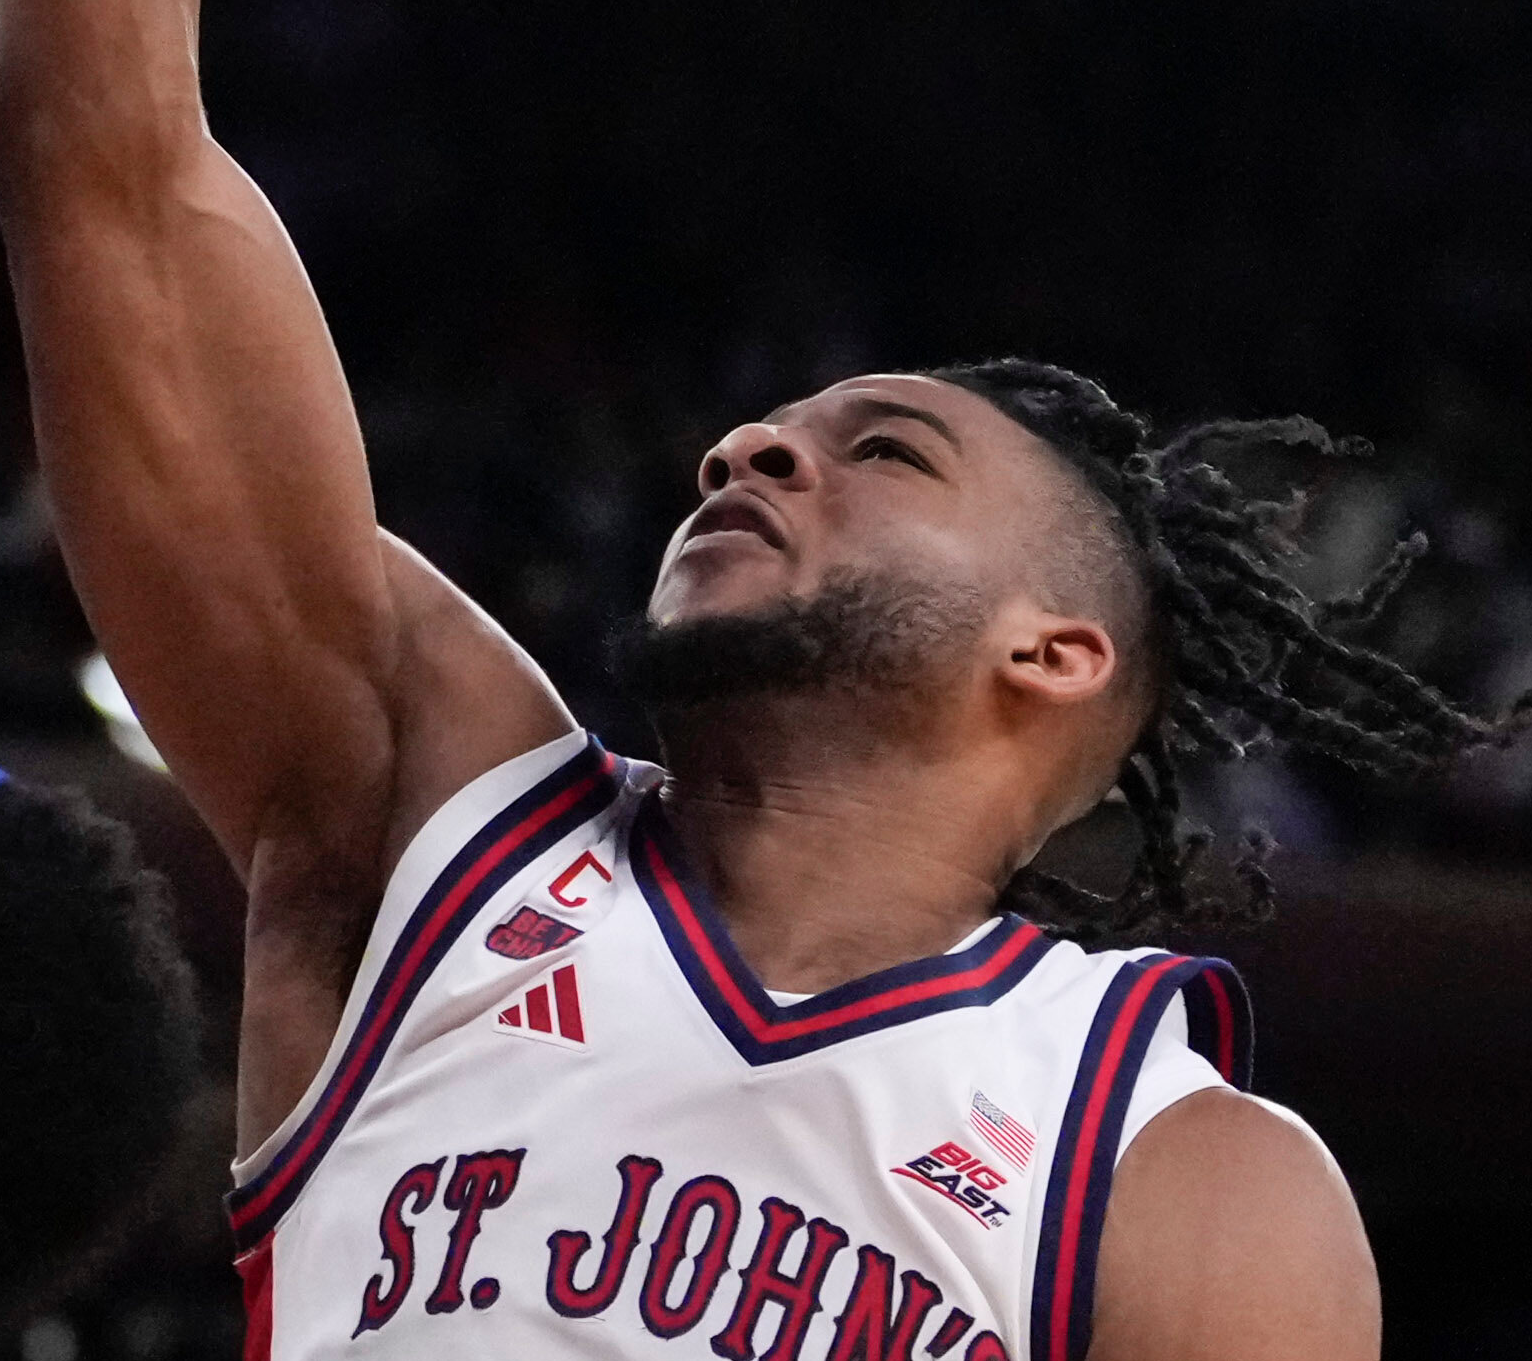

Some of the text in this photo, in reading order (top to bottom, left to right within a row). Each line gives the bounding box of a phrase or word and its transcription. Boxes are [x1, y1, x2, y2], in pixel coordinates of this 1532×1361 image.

[905, 1155, 1011, 1218] EAST
[929, 1141, 1008, 1191] BIG
[352, 1147, 528, 1340] ST.
